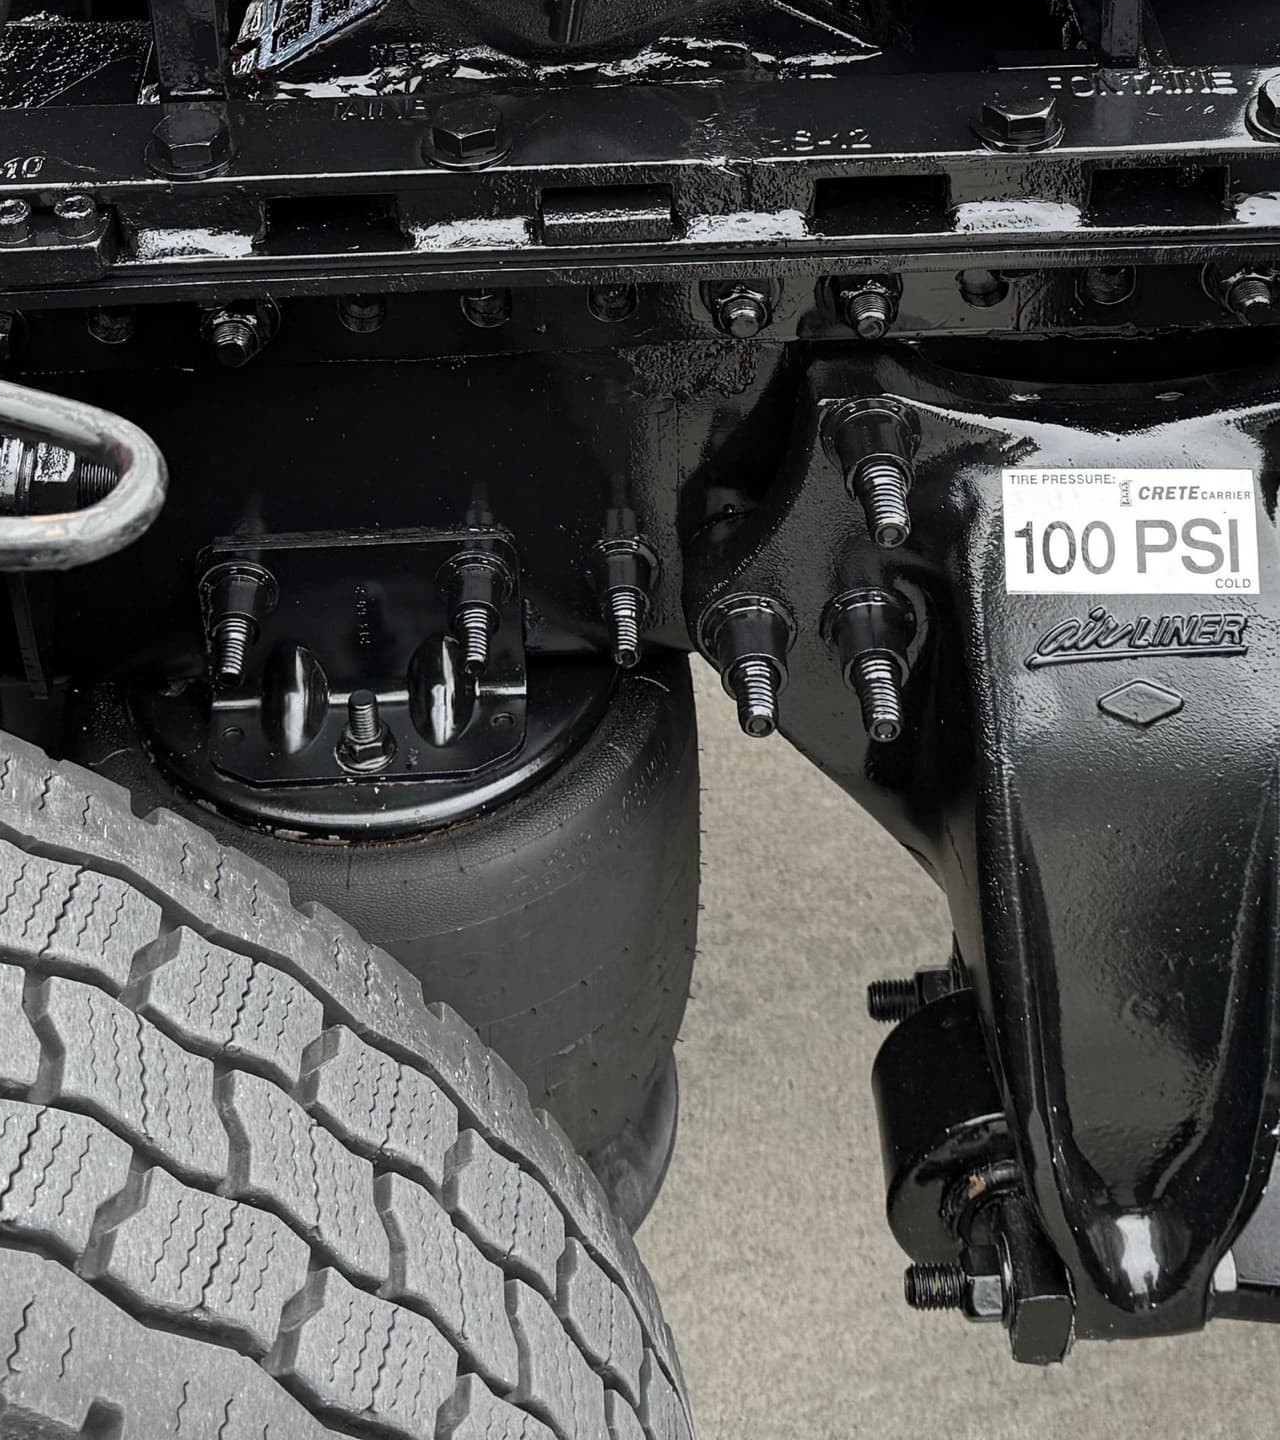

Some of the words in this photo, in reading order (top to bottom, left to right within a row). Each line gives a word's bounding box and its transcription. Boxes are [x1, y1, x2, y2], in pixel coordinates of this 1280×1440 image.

[1009, 474, 1038, 485] TIRE
[1042, 474, 1116, 485] PRESSURE:
[1138, 486, 1200, 500] CRETE
[1201, 491, 1251, 500] CARRIER
[1014, 520, 1116, 575] 100
[1135, 517, 1240, 575] PSI
[1215, 578, 1251, 589] COLD
